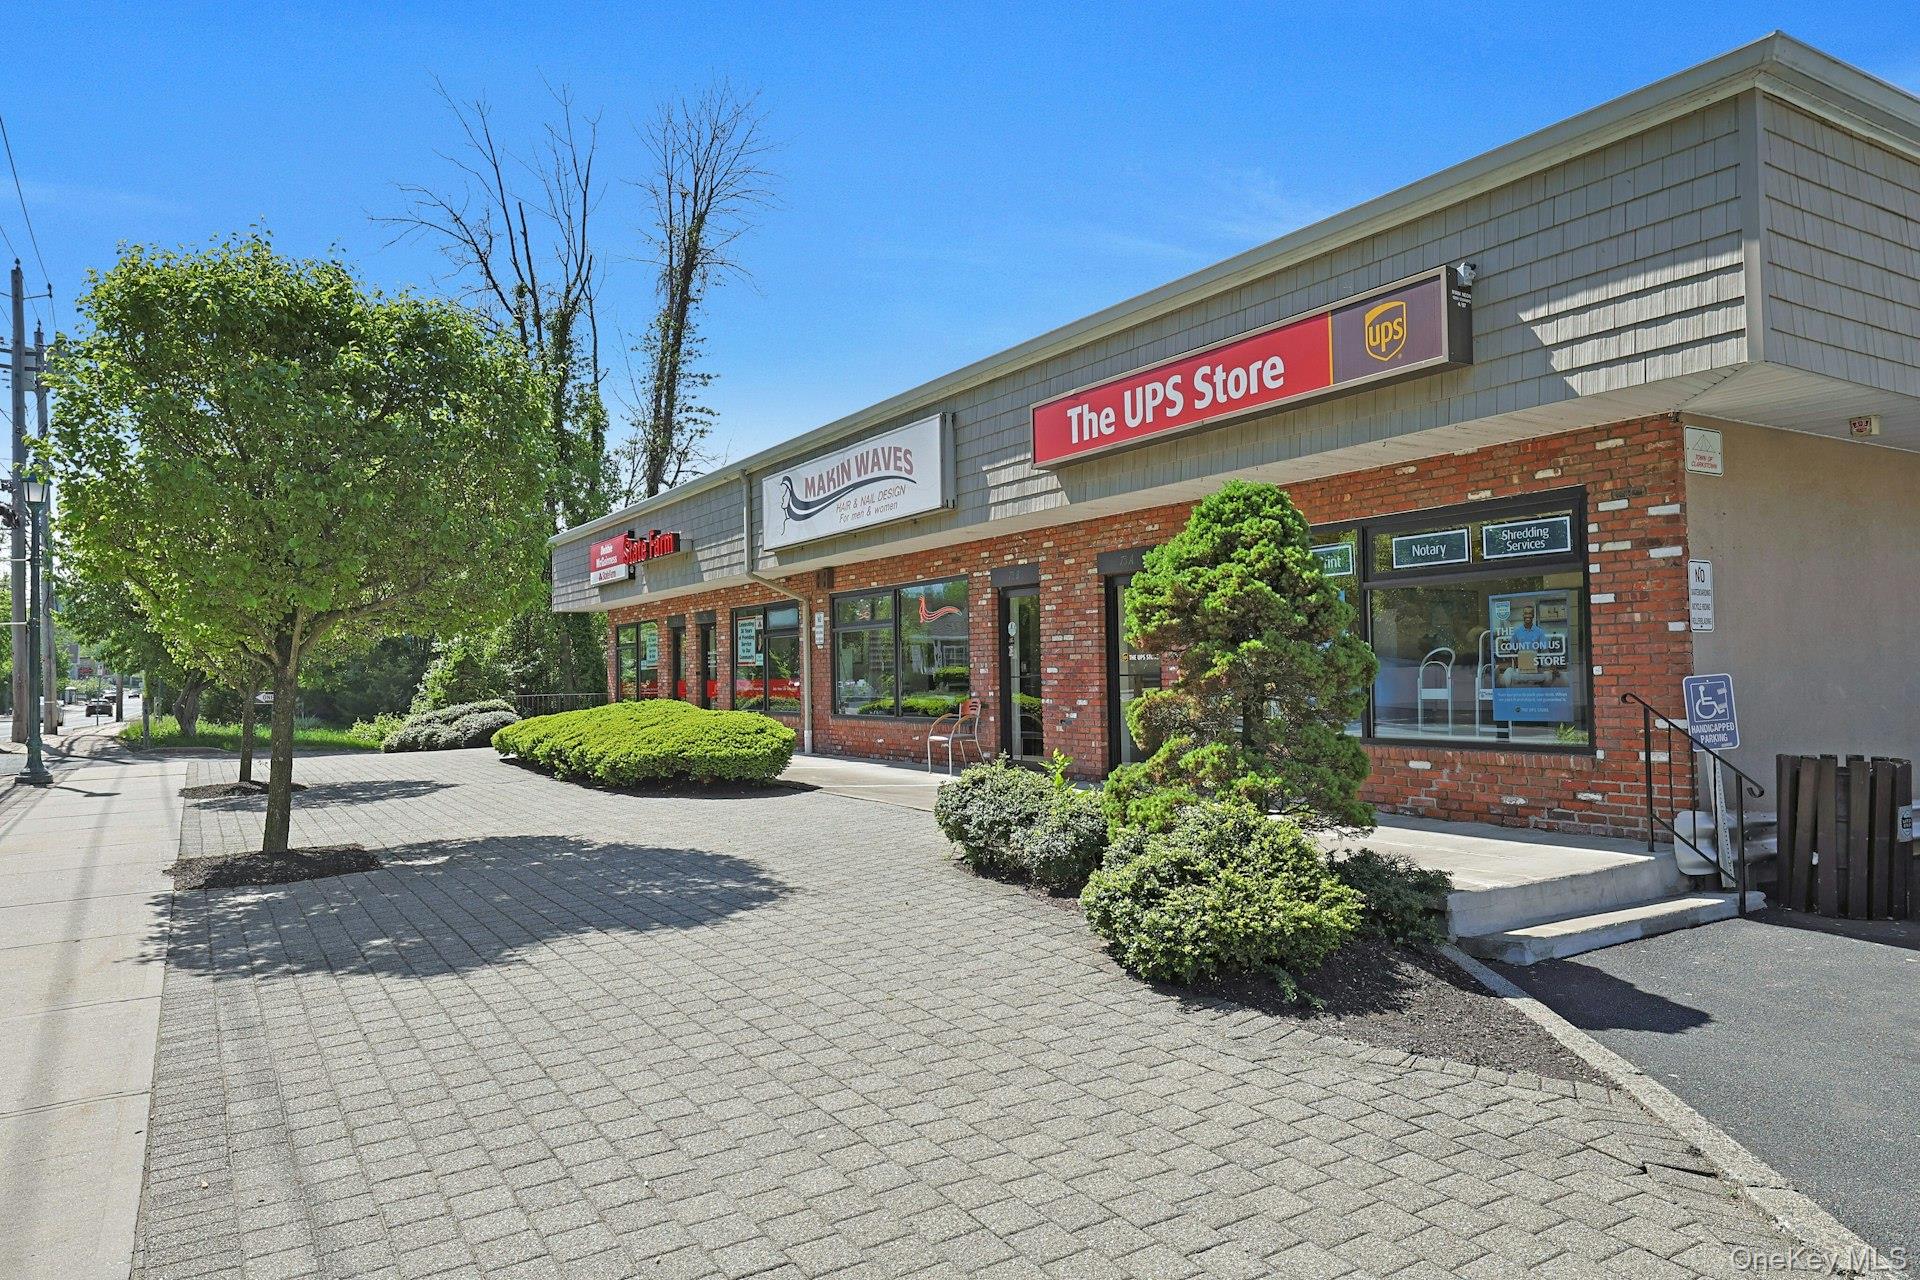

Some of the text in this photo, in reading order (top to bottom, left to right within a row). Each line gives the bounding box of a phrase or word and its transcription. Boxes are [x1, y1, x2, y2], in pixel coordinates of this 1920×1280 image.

[1368, 317, 1404, 352] ups
[1066, 355, 1285, 445] The UPS Store
[804, 446, 914, 498] MAKIN WAVES
[836, 484, 906, 513] HAIR & NAIL DESIGN
[840, 501, 898, 523] For men & women
[1500, 526, 1550, 542] Shredding
[623, 530, 673, 564] State Farm
[1412, 543, 1447, 558] Notary
[1506, 538, 1546, 552] Services
[1695, 568, 1706, 583] NO
[1496, 626, 1515, 636] THE
[1500, 640, 1560, 651] COUNT ON US
[1533, 656, 1566, 666] STORE
[1691, 722, 1735, 733] HANDICAPPED
[1700, 733, 1728, 744] PARKING
